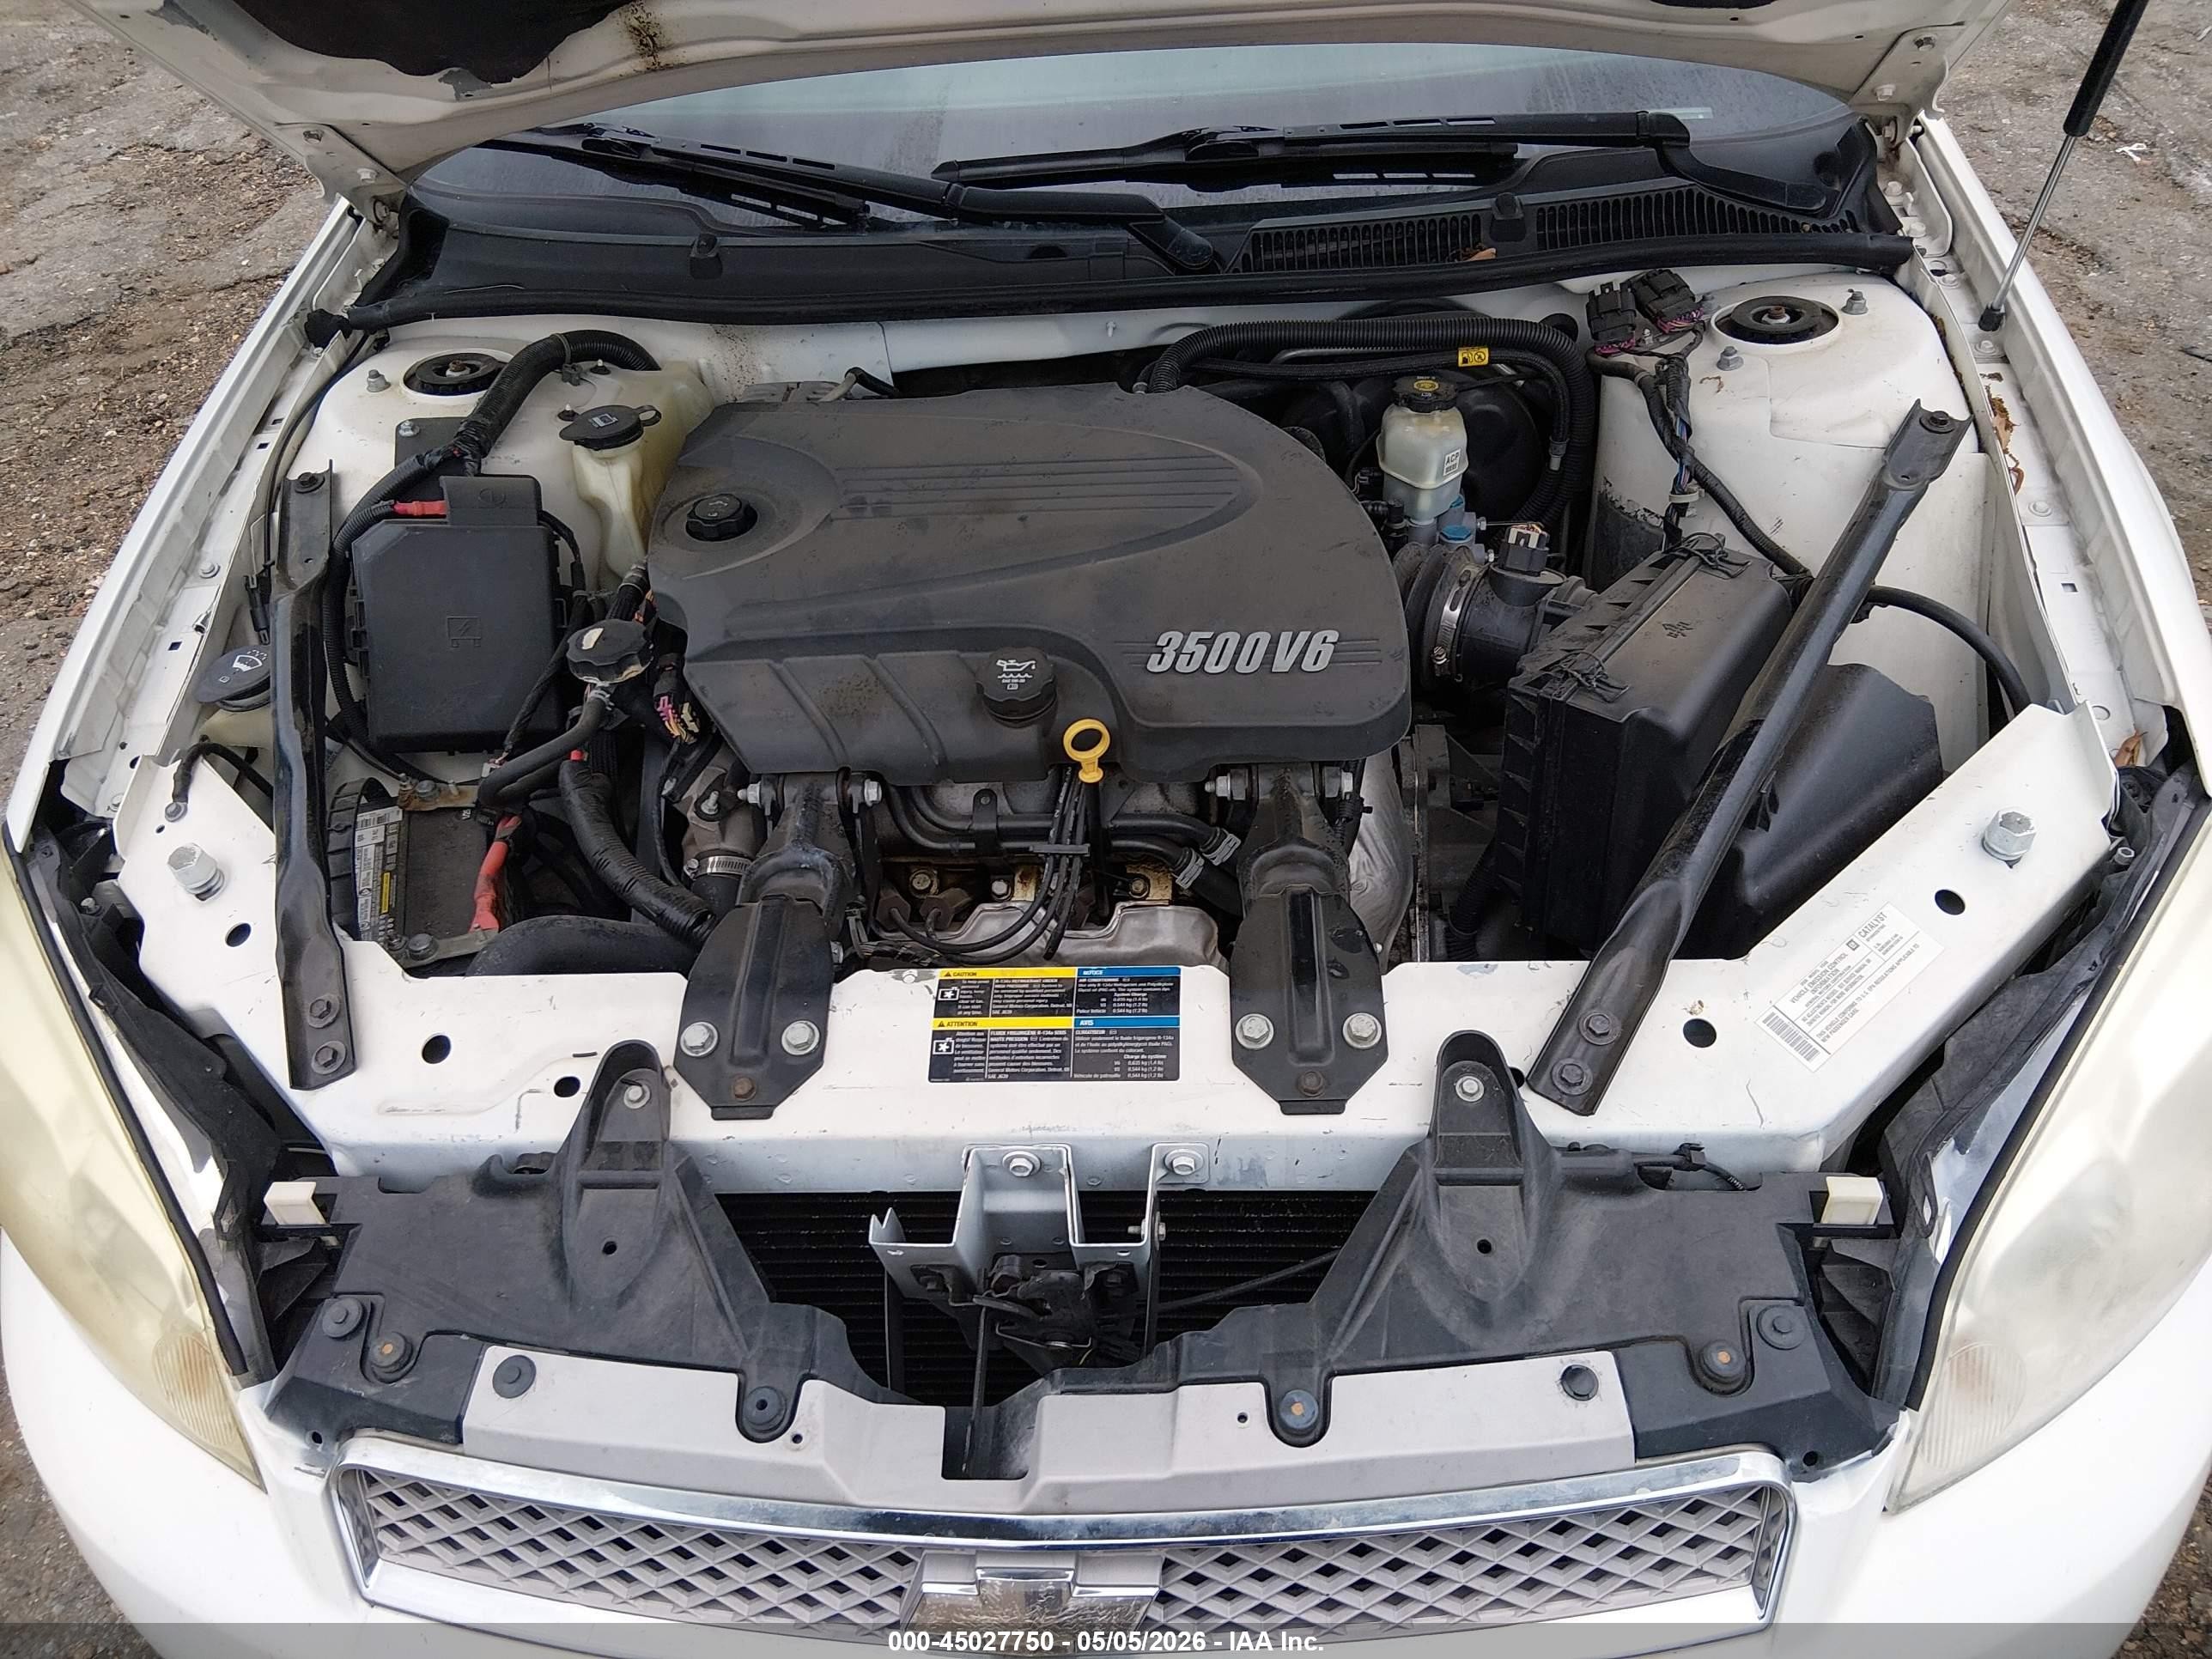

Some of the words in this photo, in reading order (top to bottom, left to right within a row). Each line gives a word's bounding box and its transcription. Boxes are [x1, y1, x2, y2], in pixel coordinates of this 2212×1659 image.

[1146, 630, 1271, 674] 3500
[1271, 630, 1340, 673] V6
[1858, 912, 1887, 938] CATALYST
